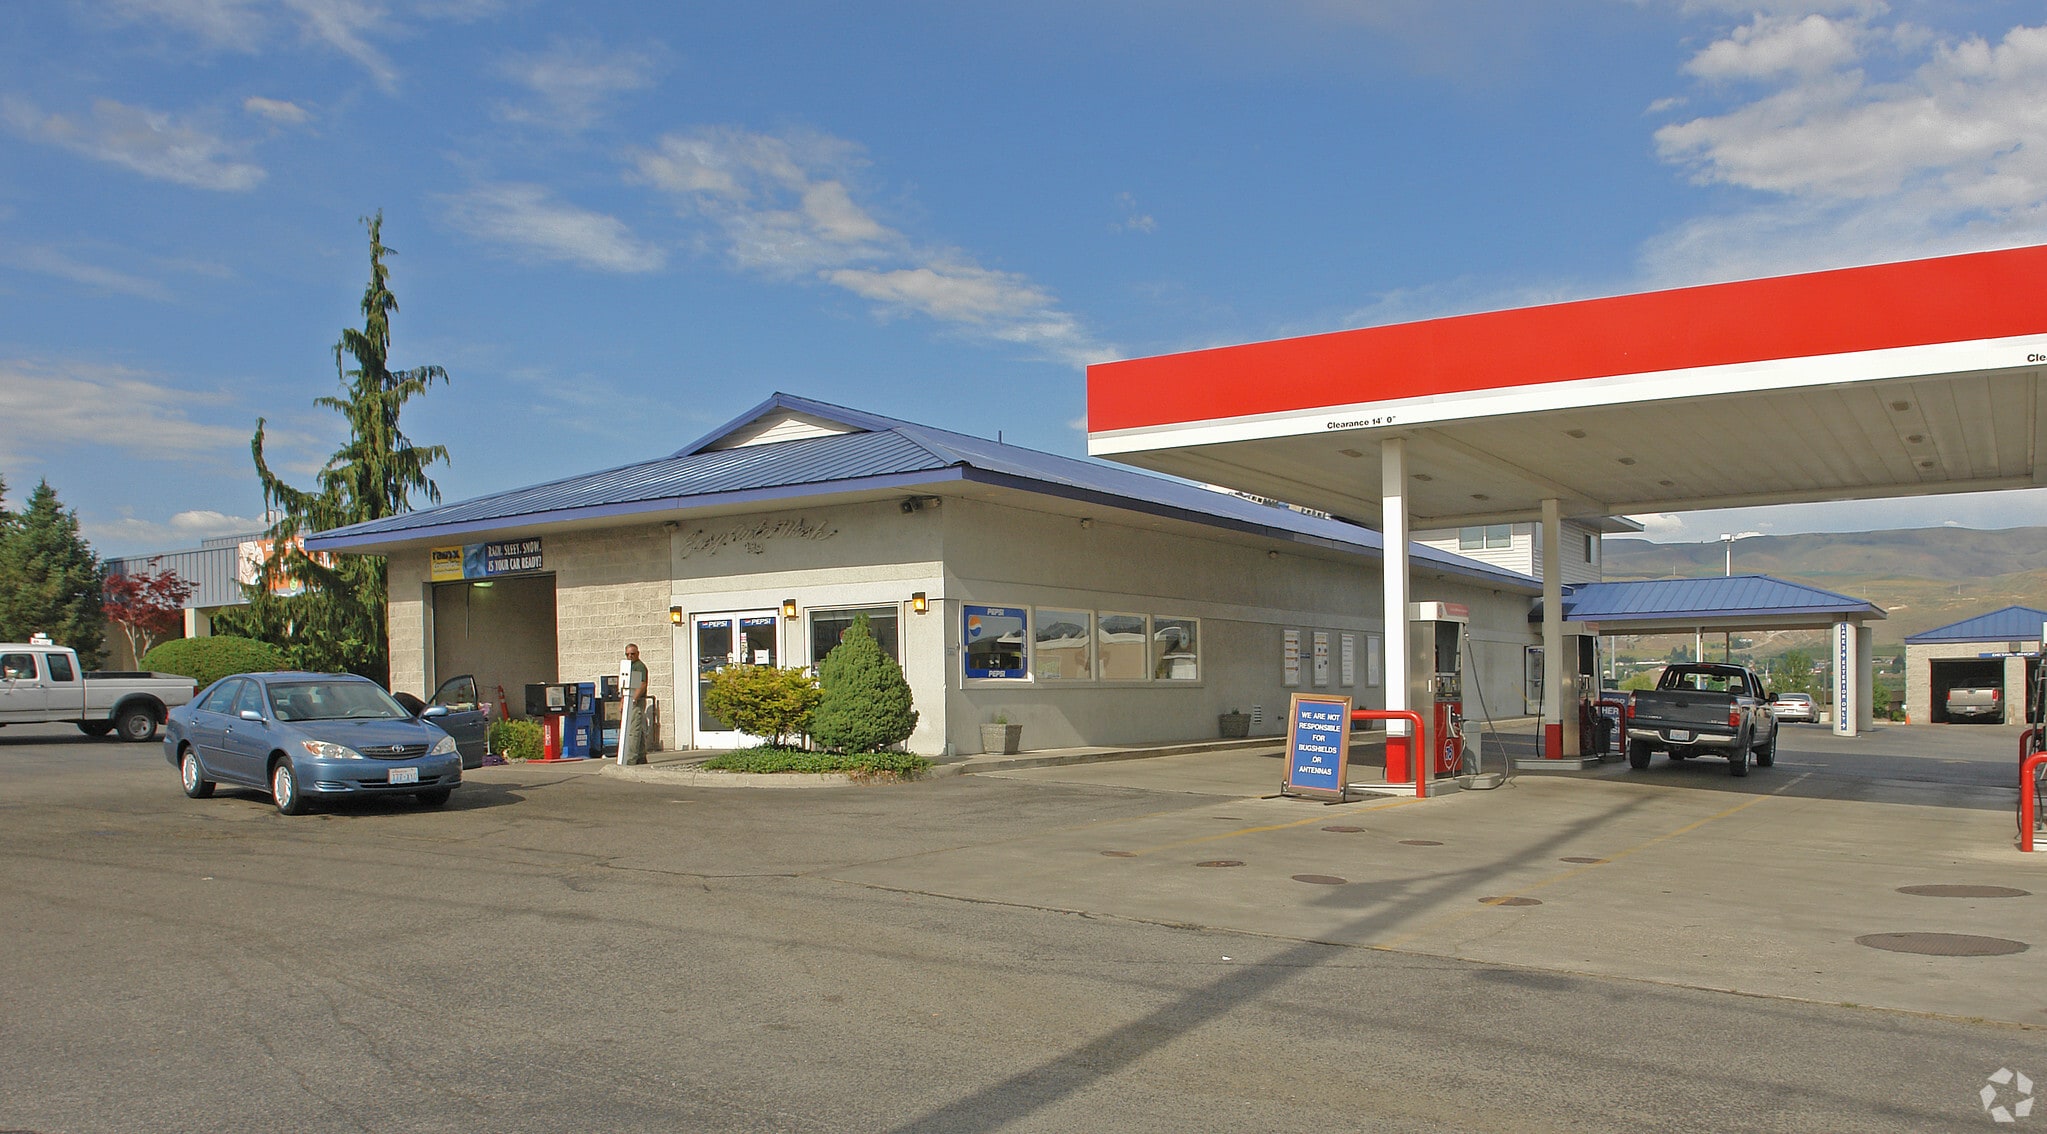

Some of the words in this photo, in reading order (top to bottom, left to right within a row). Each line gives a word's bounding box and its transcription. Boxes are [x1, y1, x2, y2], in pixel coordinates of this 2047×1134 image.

[2027, 353, 2047, 362] Cle
[1327, 420, 1369, 429] Clearance
[504, 543, 522, 556] SLEET.
[523, 541, 542, 554] SNOW.
[488, 560, 494, 572] IS
[495, 559, 509, 571] YOUR
[510, 557, 520, 570] CAR
[521, 556, 542, 569] READY?
[987, 608, 1005, 616] PEPSI
[988, 670, 1006, 678] PEPSI
[1301, 711, 1312, 719] WE
[1299, 722, 1341, 732] RESPONSIBLE
[1312, 734, 1326, 742] FOR
[1298, 744, 1337, 754] BUGSHIELDS
[1298, 766, 1332, 775] ANTENNAS
